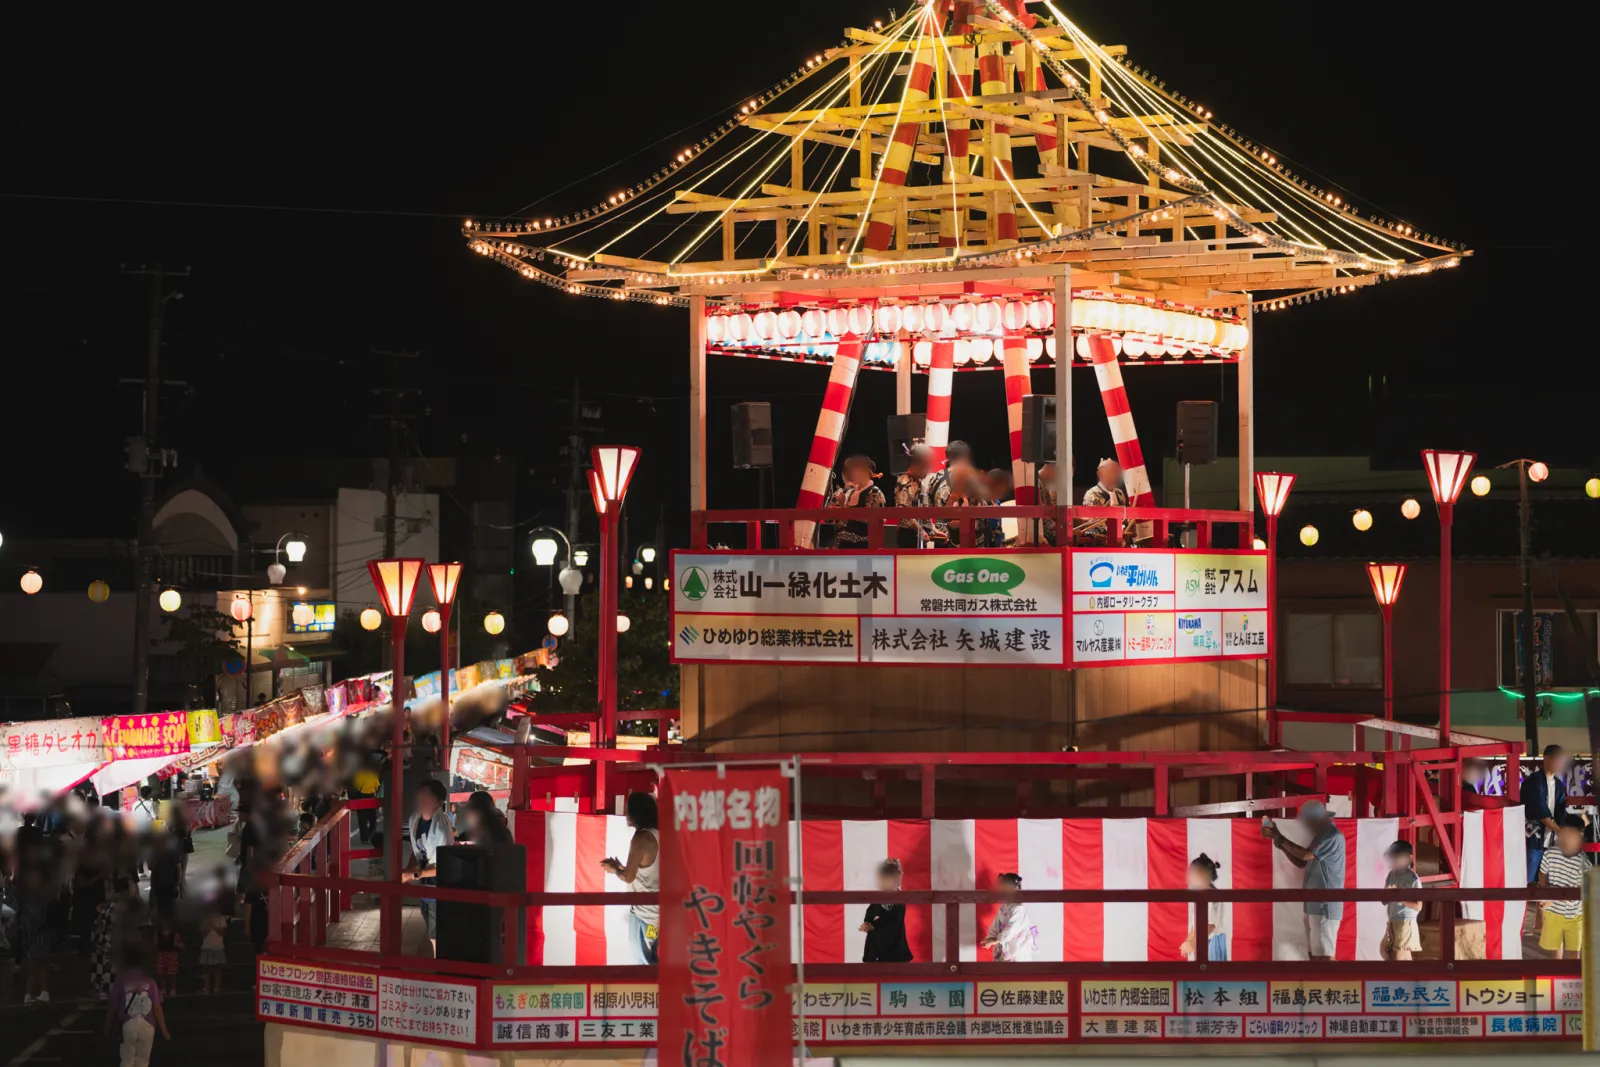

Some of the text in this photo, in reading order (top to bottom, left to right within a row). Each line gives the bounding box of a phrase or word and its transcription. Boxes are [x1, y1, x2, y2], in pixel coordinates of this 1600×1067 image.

[740, 571, 888, 599] 山一緑化土木
[943, 569, 1009, 583] Gas One
[1219, 569, 1258, 594] アスム
[920, 598, 1038, 612] 常磐共同ガス株式会社
[1097, 596, 1158, 609] 内郷ロータリークラブ
[703, 628, 853, 648] ひめゆり総業株式会社
[872, 627, 1051, 652] 株式会社 矢城建設
[1233, 631, 1264, 646] とんぼ工芸
[111, 726, 160, 747] LEMONADE
[181, 735, 234, 767] チョコレート
[673, 785, 780, 832] 内郷名物
[733, 840, 777, 1011] 回転やぐら
[683, 885, 727, 1067] やきそば
[262, 984, 312, 1001] 四家酒造店
[351, 995, 370, 1009] 清酒
[495, 992, 585, 1010] もえぎの森保育園
[792, 992, 872, 1007] わきアルミ
[889, 989, 965, 1008] 駒造園
[1001, 990, 1064, 1006] 佐藤建設
[1185, 986, 1259, 1006] 松本組
[1272, 987, 1360, 1006] 福島民報社
[1372, 986, 1450, 1003] 福島民友
[1465, 988, 1544, 1006] トウショー
[262, 1001, 374, 1029] 内郷新聞販売 うちわ
[381, 1000, 471, 1020] ゴミステーションがあります
[497, 1023, 570, 1040] 誠信商事
[582, 1022, 654, 1038] 三友工業
[831, 1020, 1064, 1036] いわき市青少年育成市民会議 内郷地区推進協議会
[1085, 1020, 1157, 1034] 大喜建築
[1195, 1020, 1238, 1034] 瑞芳寺
[1249, 1020, 1318, 1034] ごらい歯科クリニック
[1417, 1026, 1470, 1035] 事業協同組合
[1491, 1017, 1557, 1033] 長橋病院
